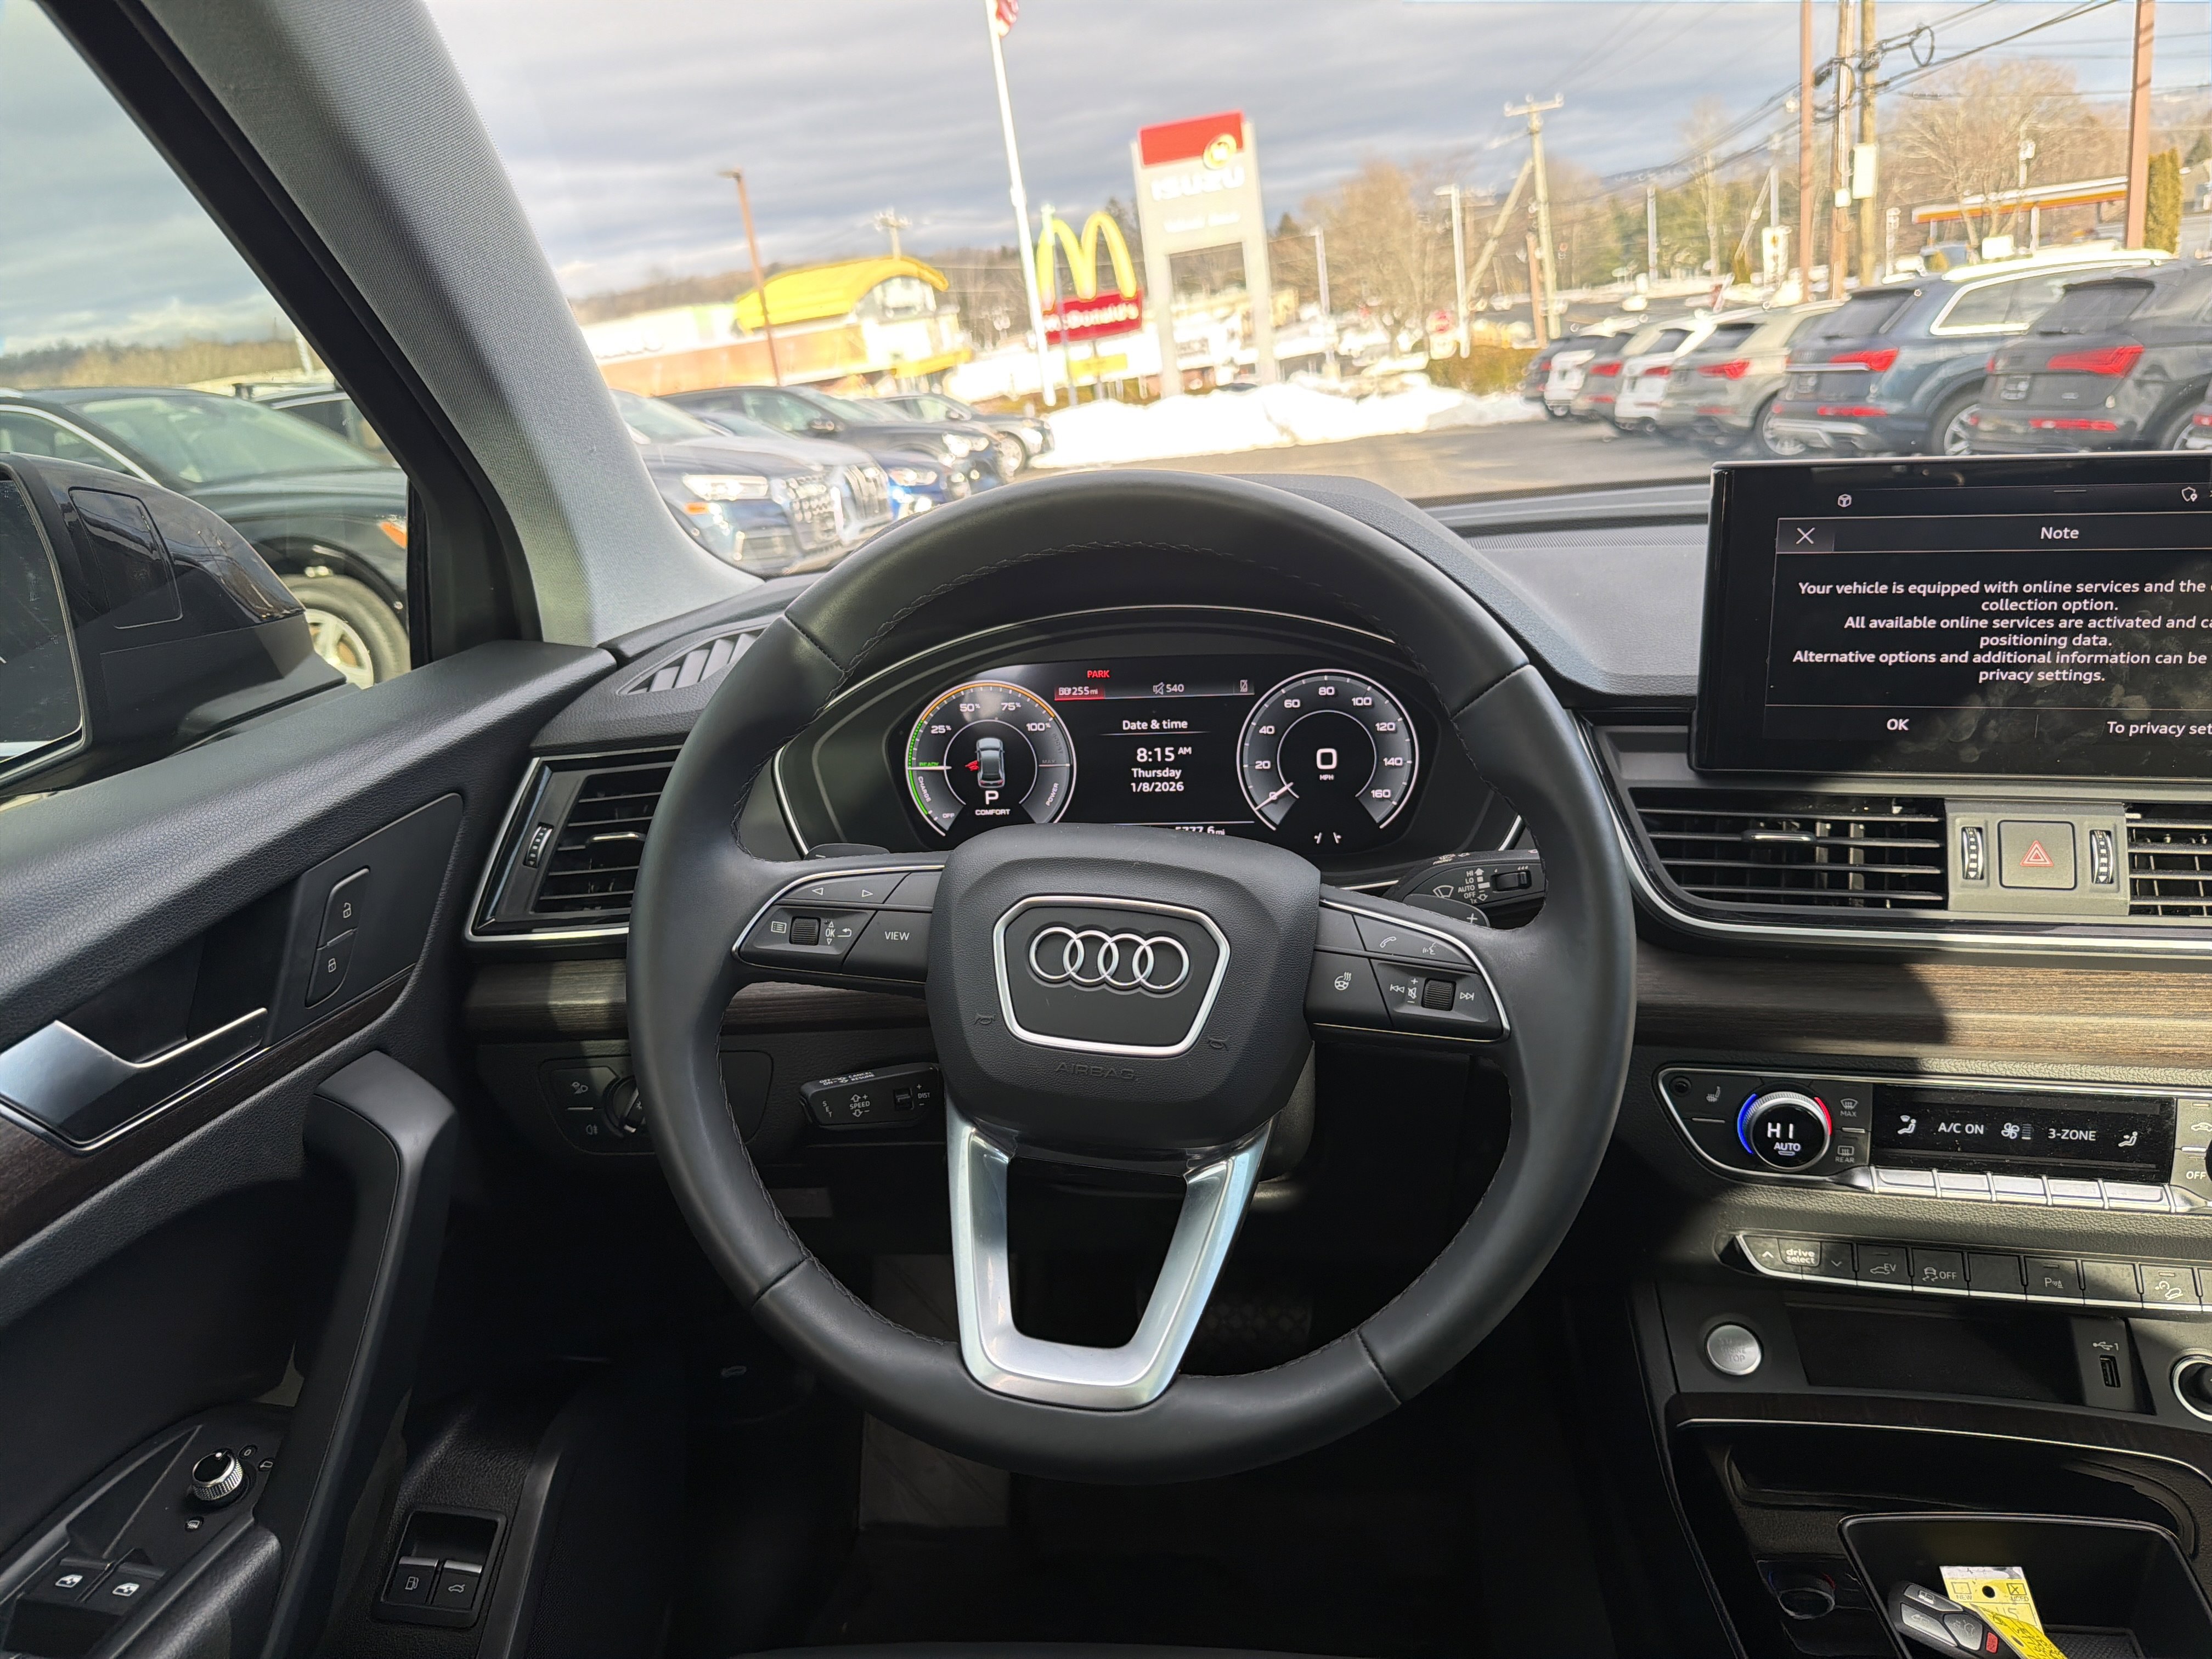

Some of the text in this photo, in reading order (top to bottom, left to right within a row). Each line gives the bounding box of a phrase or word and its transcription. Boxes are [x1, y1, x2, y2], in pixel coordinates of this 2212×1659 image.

[1152, 166, 1245, 201] ISUZU
[2040, 527, 2079, 539] Note
[1798, 582, 1833, 594] Your
[1836, 581, 1888, 594] vehicle
[1892, 582, 1904, 594] is
[1908, 580, 1980, 597] equipped
[1984, 580, 2018, 594] with
[2023, 580, 2072, 593] online
[2075, 580, 2140, 593] services
[2143, 579, 2175, 592] and
[2179, 579, 2204, 592] the
[1981, 598, 2118, 614] collection option.
[1844, 616, 1866, 629] All
[1869, 616, 1937, 629] available
[1940, 616, 1989, 629] online
[1992, 616, 2055, 629] services
[2058, 619, 2084, 629] are
[2087, 615, 2162, 629] activated
[2165, 615, 2197, 629] and
[1979, 633, 2112, 649] positioning data.
[1792, 650, 2208, 666] Alternative options and additional information can be
[1087, 670, 1110, 678] PARK
[1978, 668, 2105, 684] privacy settings.
[1166, 684, 1185, 693] 540
[1318, 687, 1335, 696] 80
[1001, 702, 1021, 711] 75%
[1284, 699, 1300, 708] 60
[1351, 697, 1372, 706] 100
[960, 703, 980, 712] 50%
[931, 725, 951, 734] 25%
[1026, 723, 1051, 731] 100%
[1122, 719, 1188, 730] Date & time
[1375, 722, 1396, 731] 120
[1887, 718, 1909, 731] OK
[2107, 721, 2125, 733] To
[2129, 721, 2186, 737] privacy
[1259, 725, 1275, 735] 40
[1136, 747, 1192, 763] 8:15 AM
[1316, 748, 1338, 770] 0
[1255, 760, 1271, 769] 20
[1383, 757, 1403, 766] 140
[1131, 767, 1182, 780] Thursday
[918, 776, 932, 803] CHARGE
[1131, 781, 1184, 792] 1/8/2026
[985, 790, 999, 805] P
[1046, 783, 1059, 806] POWER
[1371, 789, 1391, 798] 160
[825, 928, 836, 938] OK
[885, 931, 910, 941] VIEW
[1055, 1062, 1135, 1080] AIRBAG
[850, 1101, 870, 1110] SPEED
[1767, 1122, 1794, 1140] HI
[1938, 1122, 1984, 1135] A/C ON
[2048, 1128, 2097, 1142] 3-ZONE
[1773, 1142, 1801, 1152] AUTO
[1835, 1155, 1855, 1164] REAR
[2186, 1171, 2206, 1180] OFF
[1786, 1248, 1815, 1258] drive
[1786, 1256, 1815, 1265] select
[1883, 1263, 1897, 1272] EV
[1939, 1271, 1957, 1281] OFF
